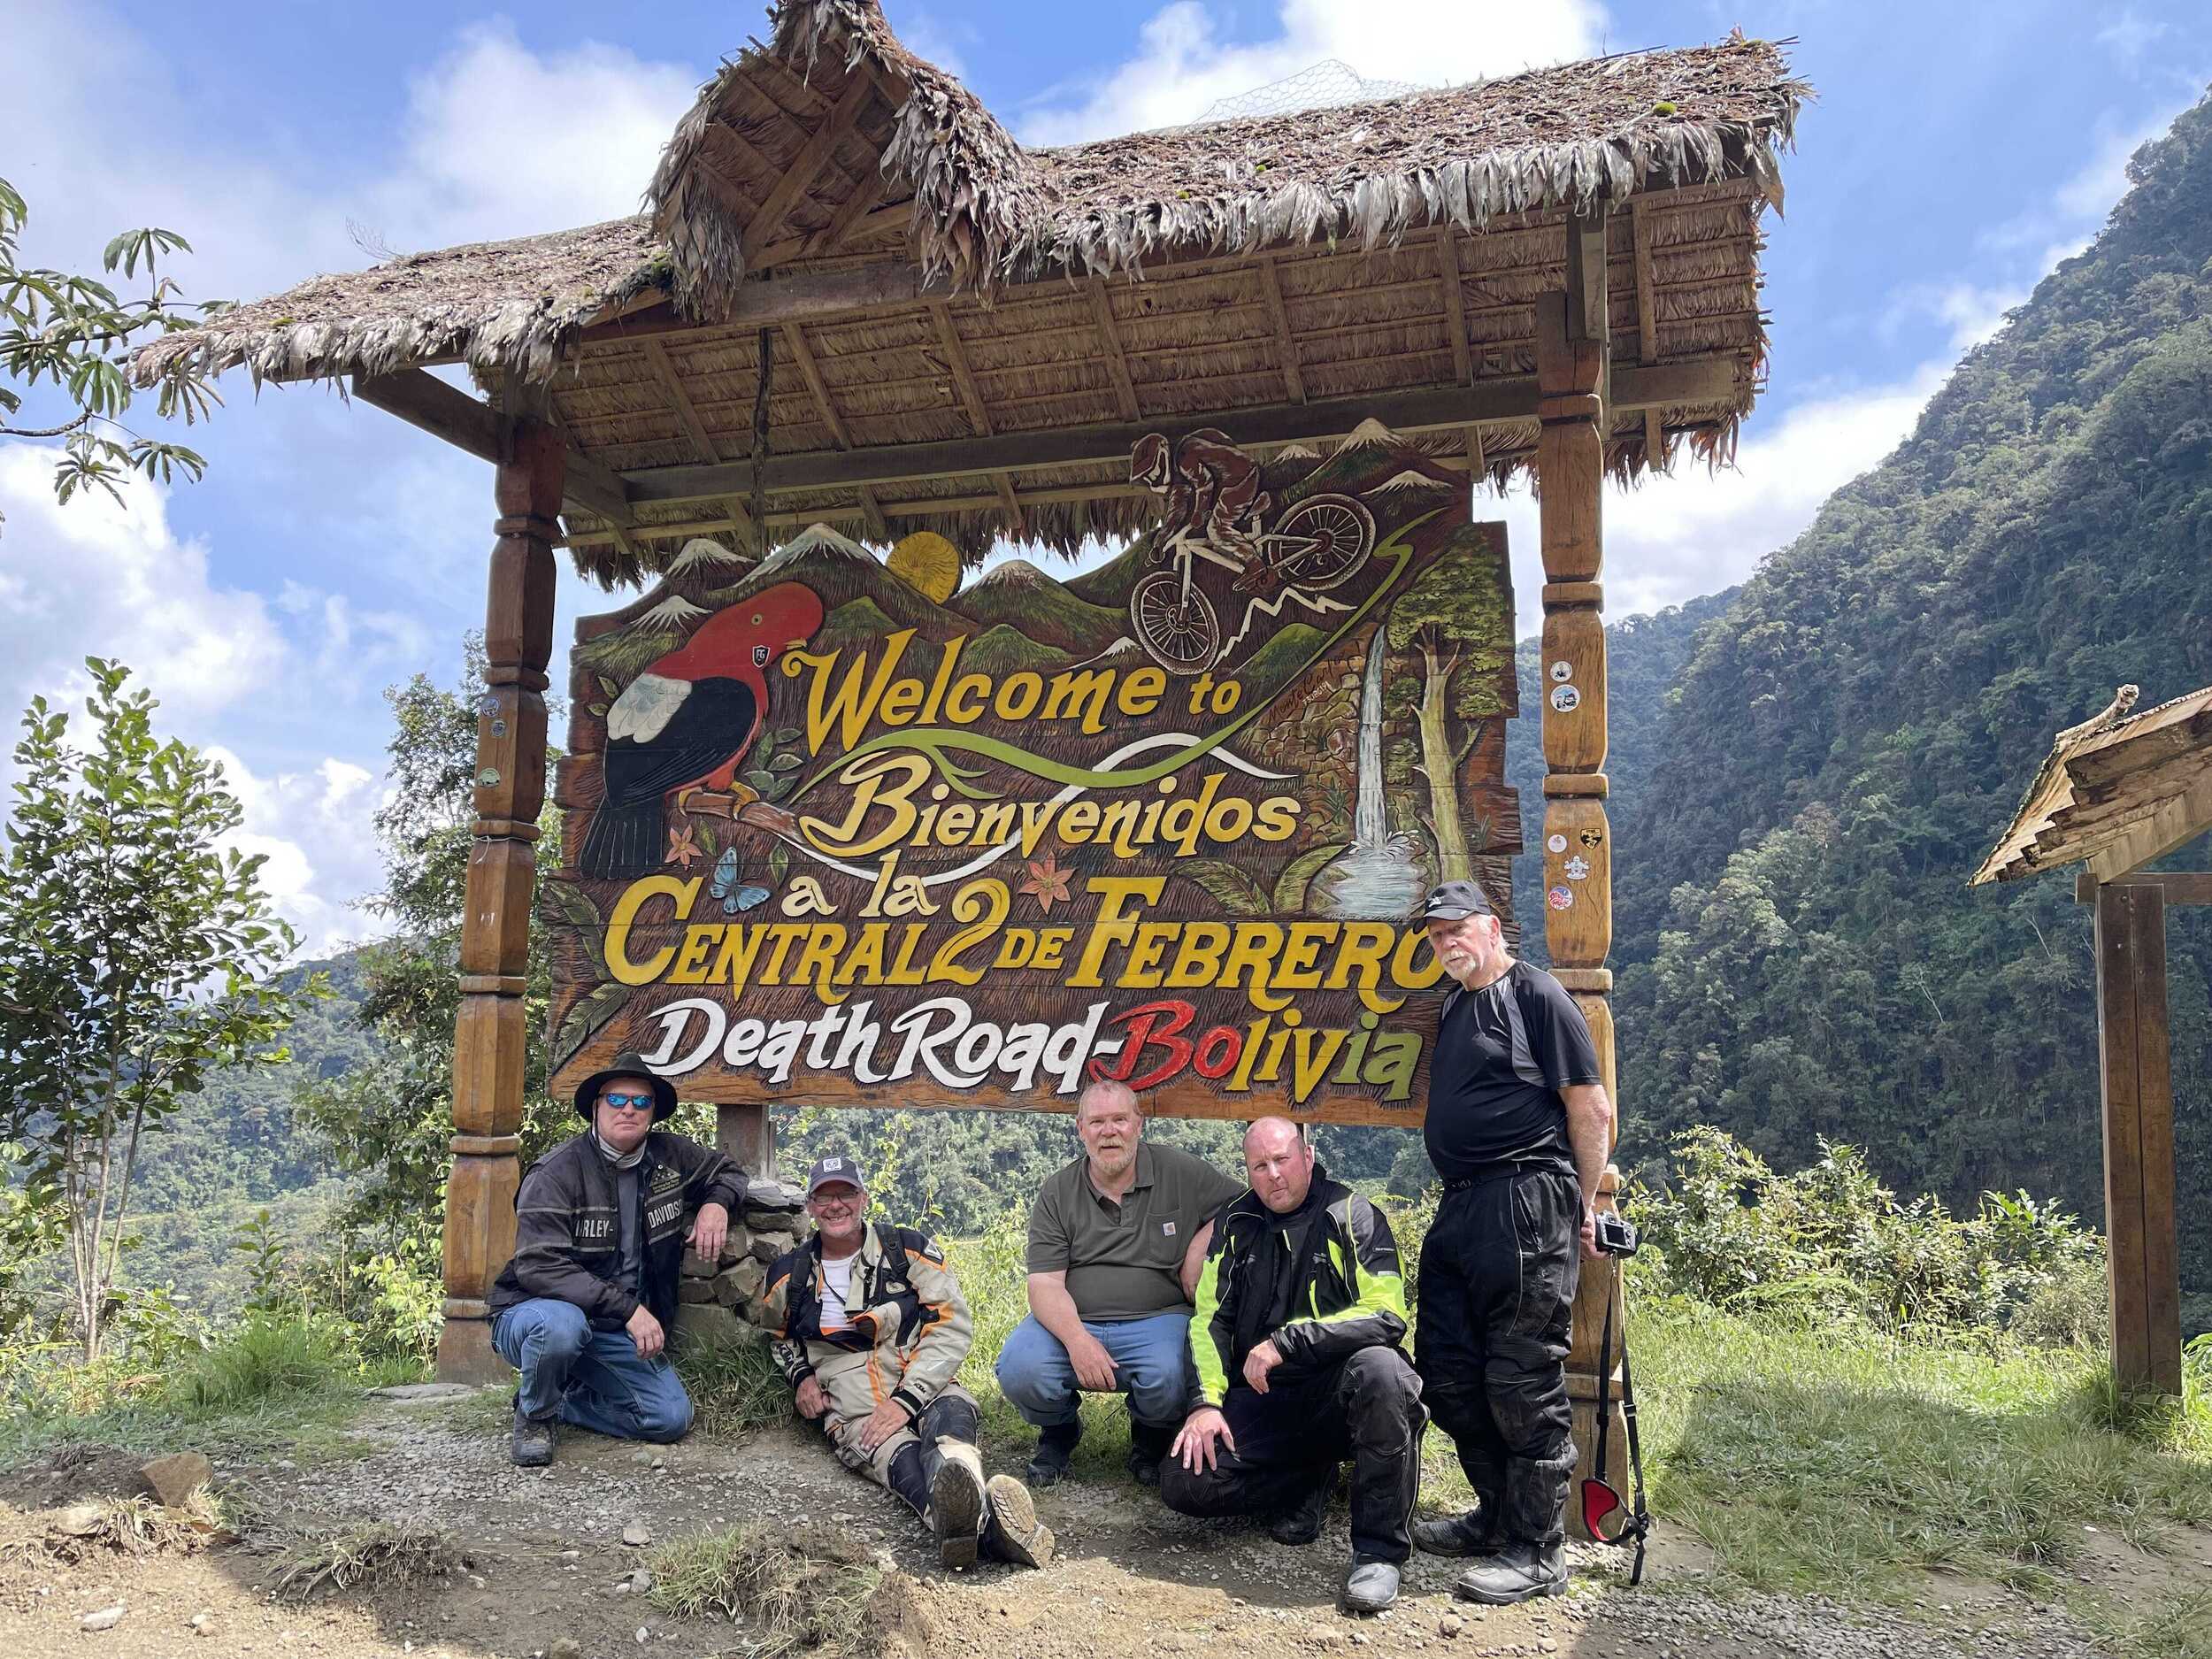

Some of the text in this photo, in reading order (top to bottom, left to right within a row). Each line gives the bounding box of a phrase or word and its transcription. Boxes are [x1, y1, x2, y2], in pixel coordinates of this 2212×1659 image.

[781, 628, 1241, 757] Welcome to
[798, 750, 1302, 859] Bienvenidos
[782, 849, 941, 918] a la
[603, 874, 1448, 1014] CENTRAL 2 DE FEBRERO
[640, 997, 888, 1085] Death
